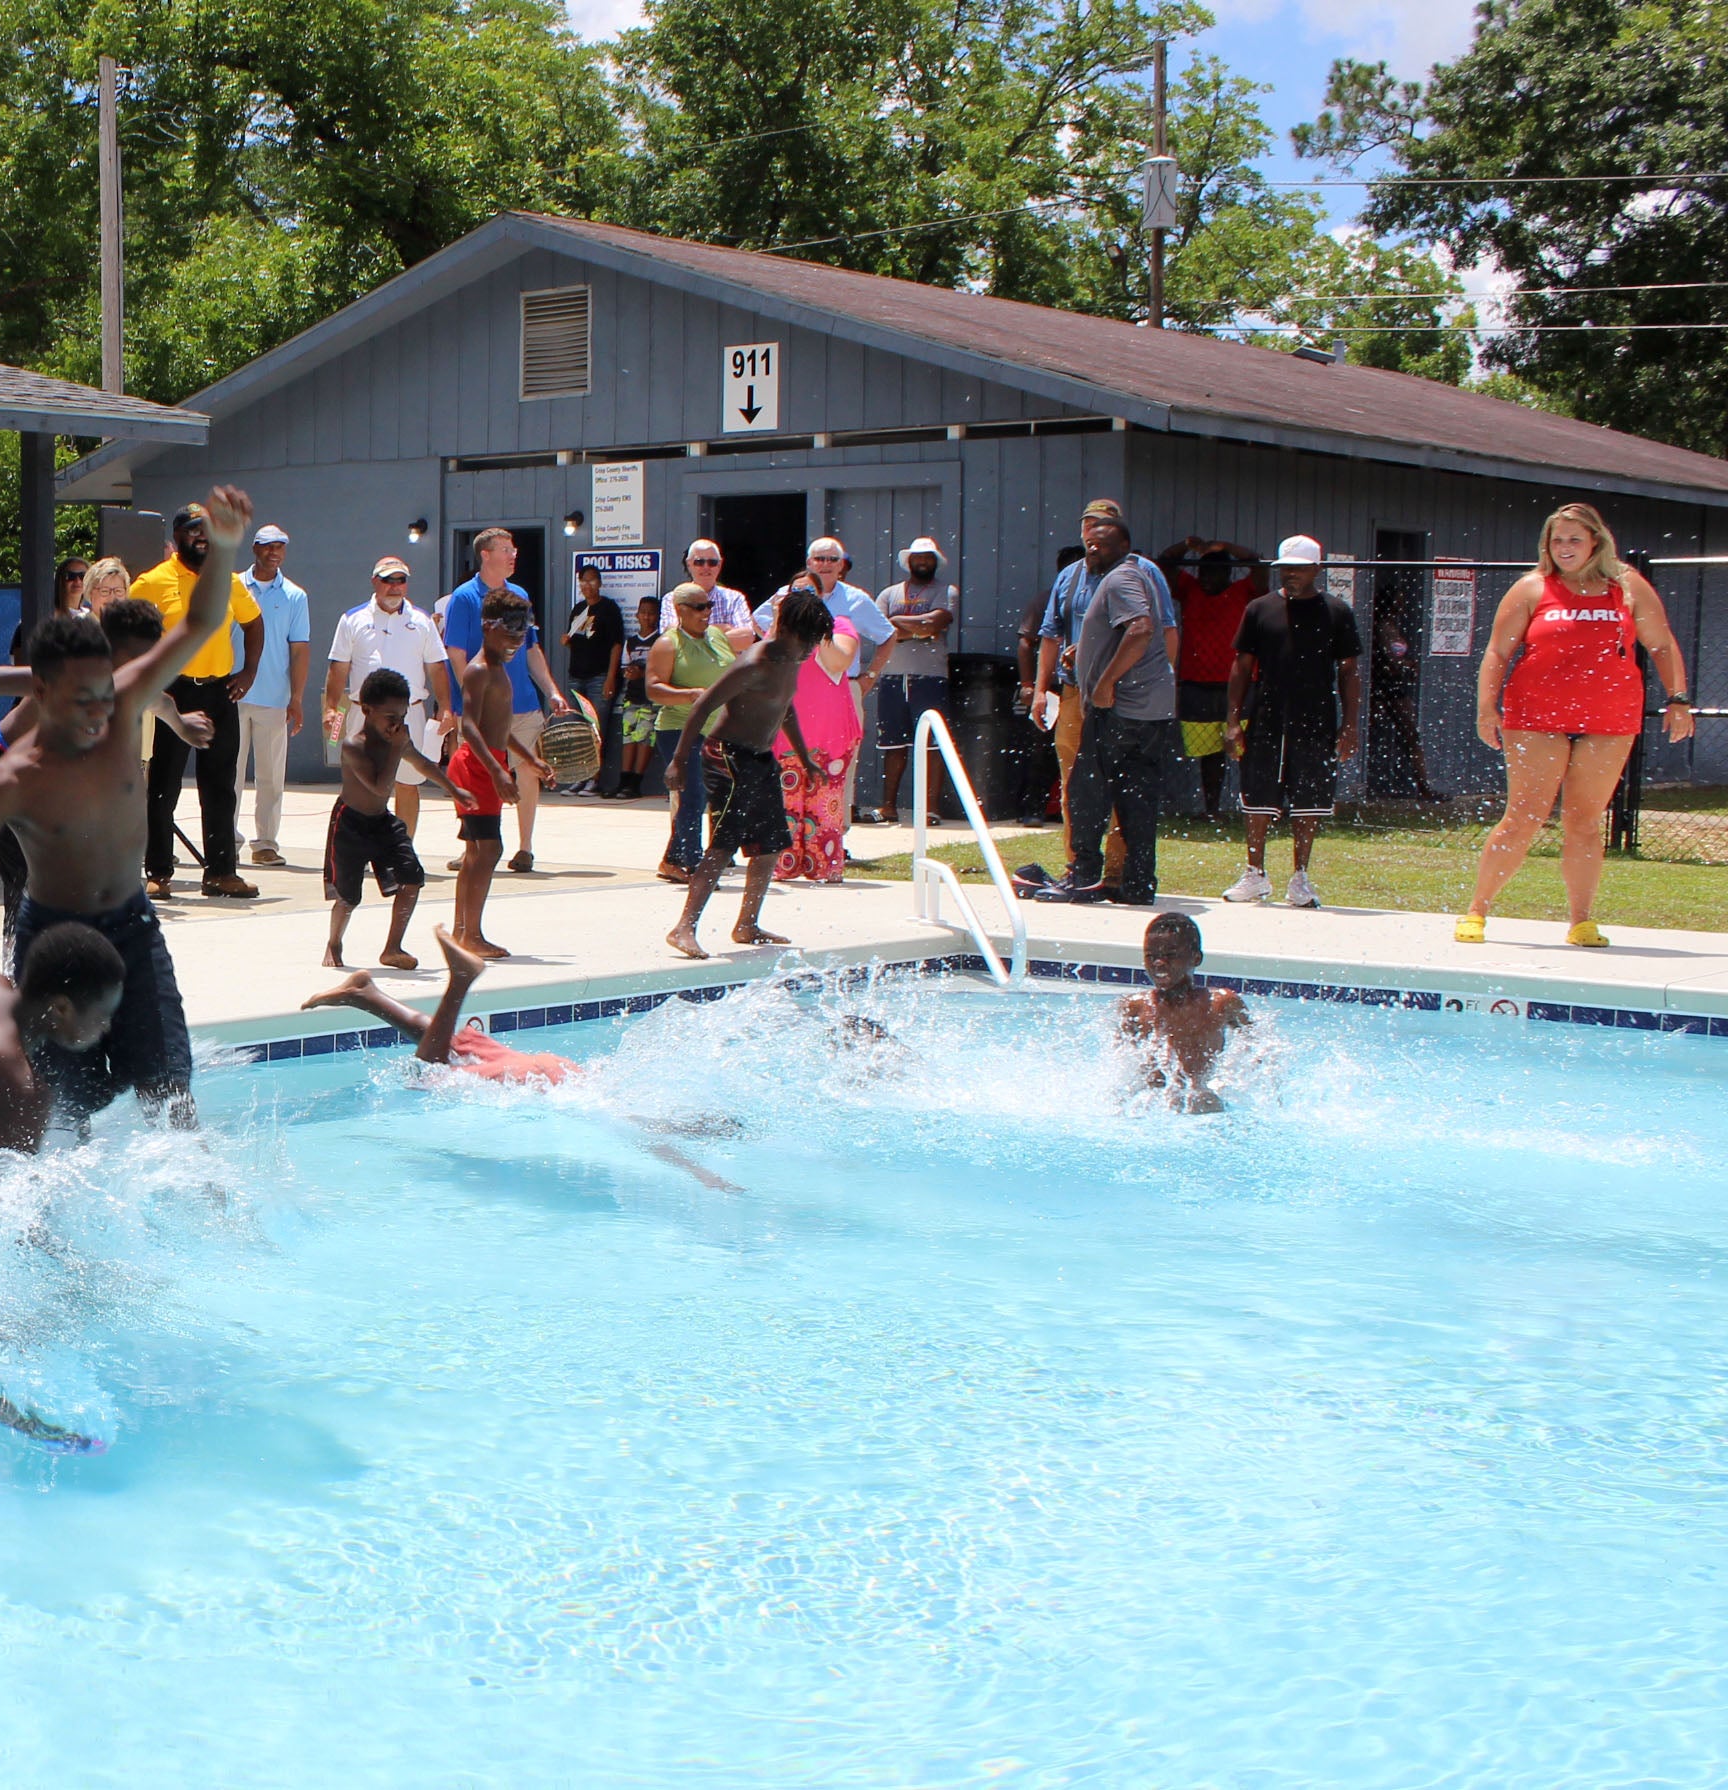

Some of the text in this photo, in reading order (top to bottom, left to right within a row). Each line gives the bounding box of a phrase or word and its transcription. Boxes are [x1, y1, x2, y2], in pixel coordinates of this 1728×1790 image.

[732, 348, 770, 379] 911
[607, 466, 621, 474] County
[607, 495, 621, 504] County
[607, 524, 621, 532] County
[583, 555, 651, 570] POOL RISKS
[1544, 609, 1624, 622] GUARD
